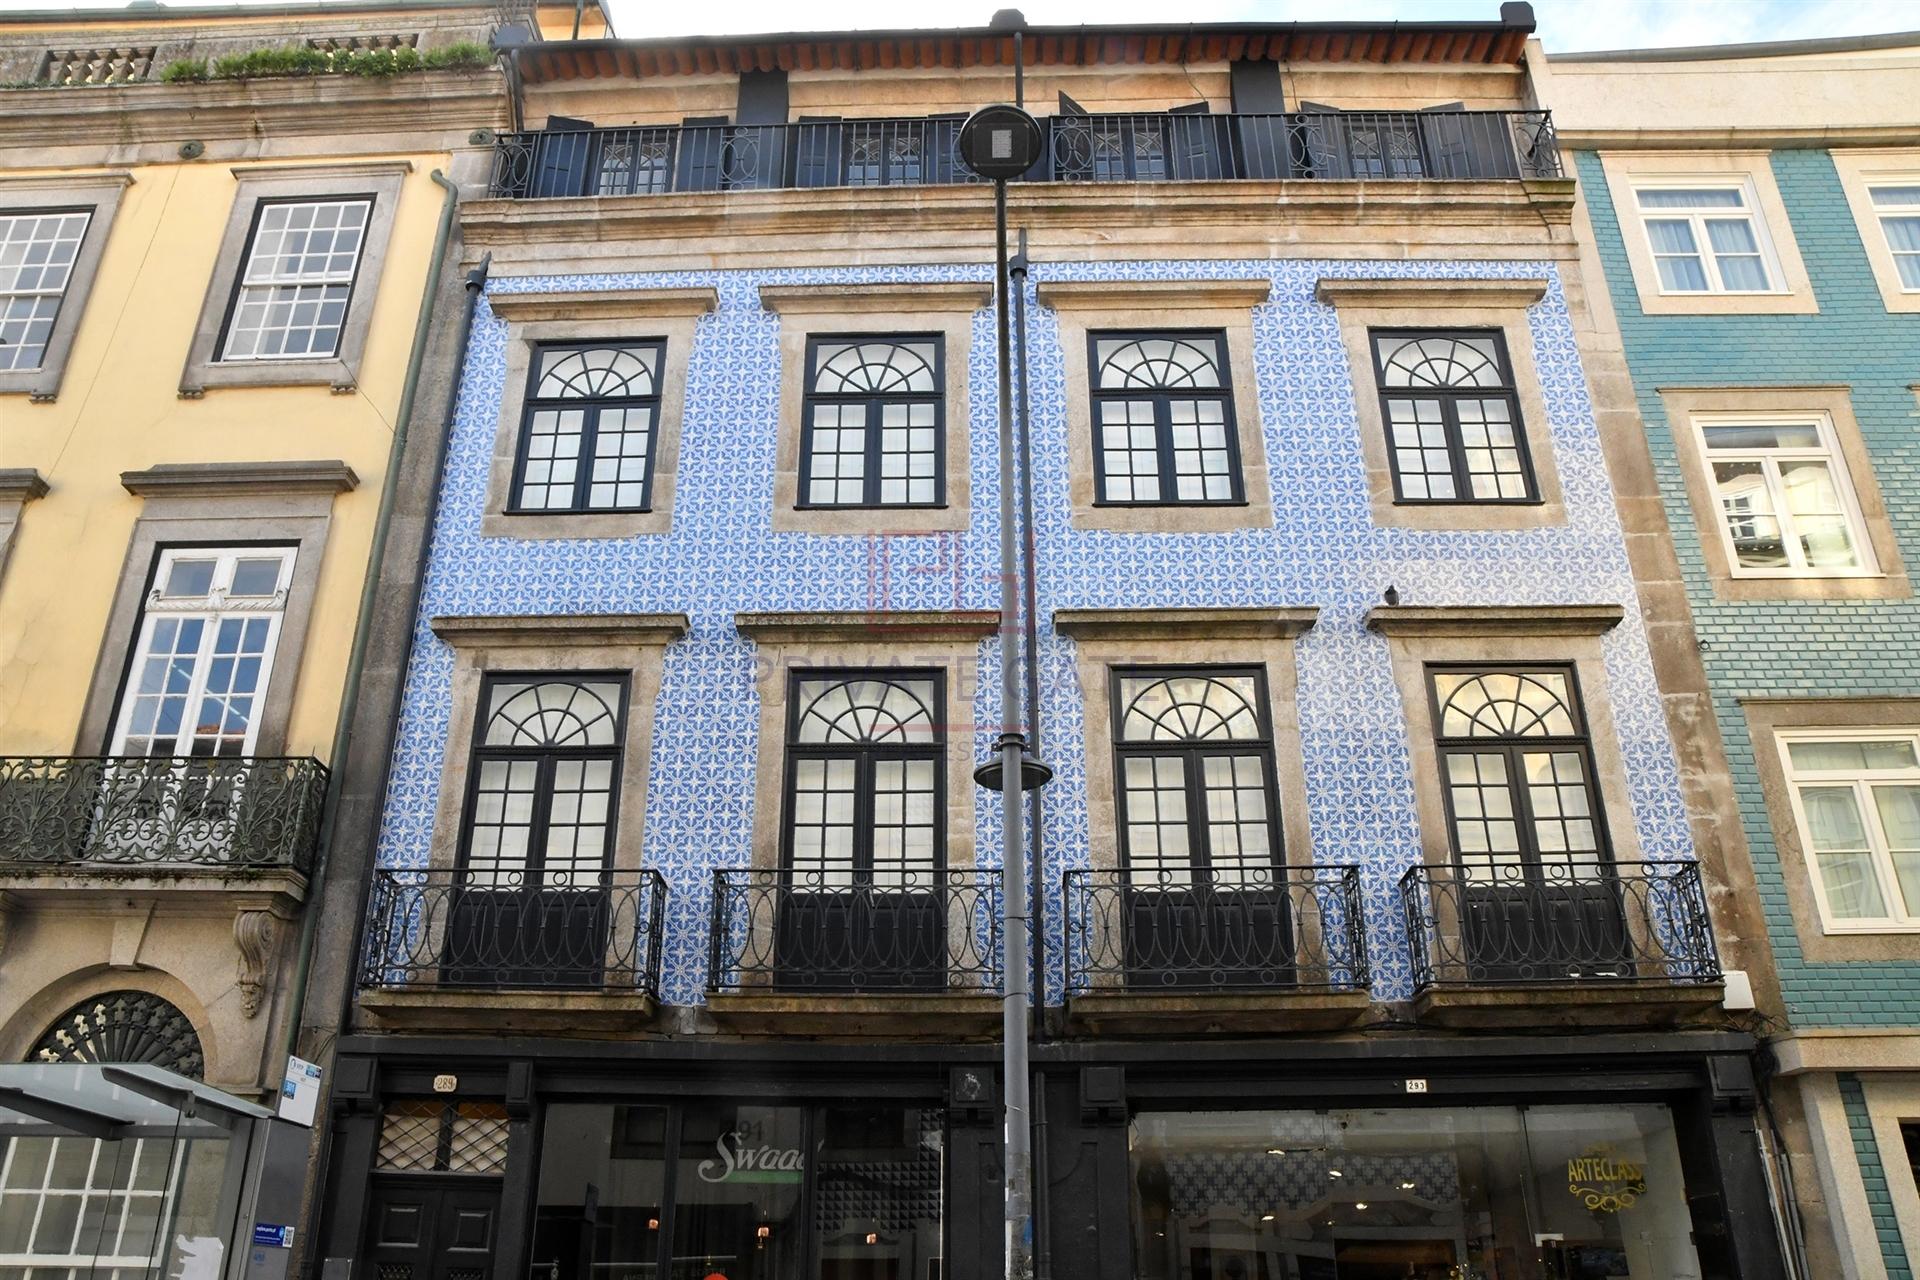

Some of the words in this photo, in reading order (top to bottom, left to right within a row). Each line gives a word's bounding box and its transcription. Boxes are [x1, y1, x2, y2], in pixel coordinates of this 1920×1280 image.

[437, 1077, 454, 1090] 289
[1408, 1080, 1425, 1090] 293
[1567, 1157, 1643, 1182] ARTECLASS
